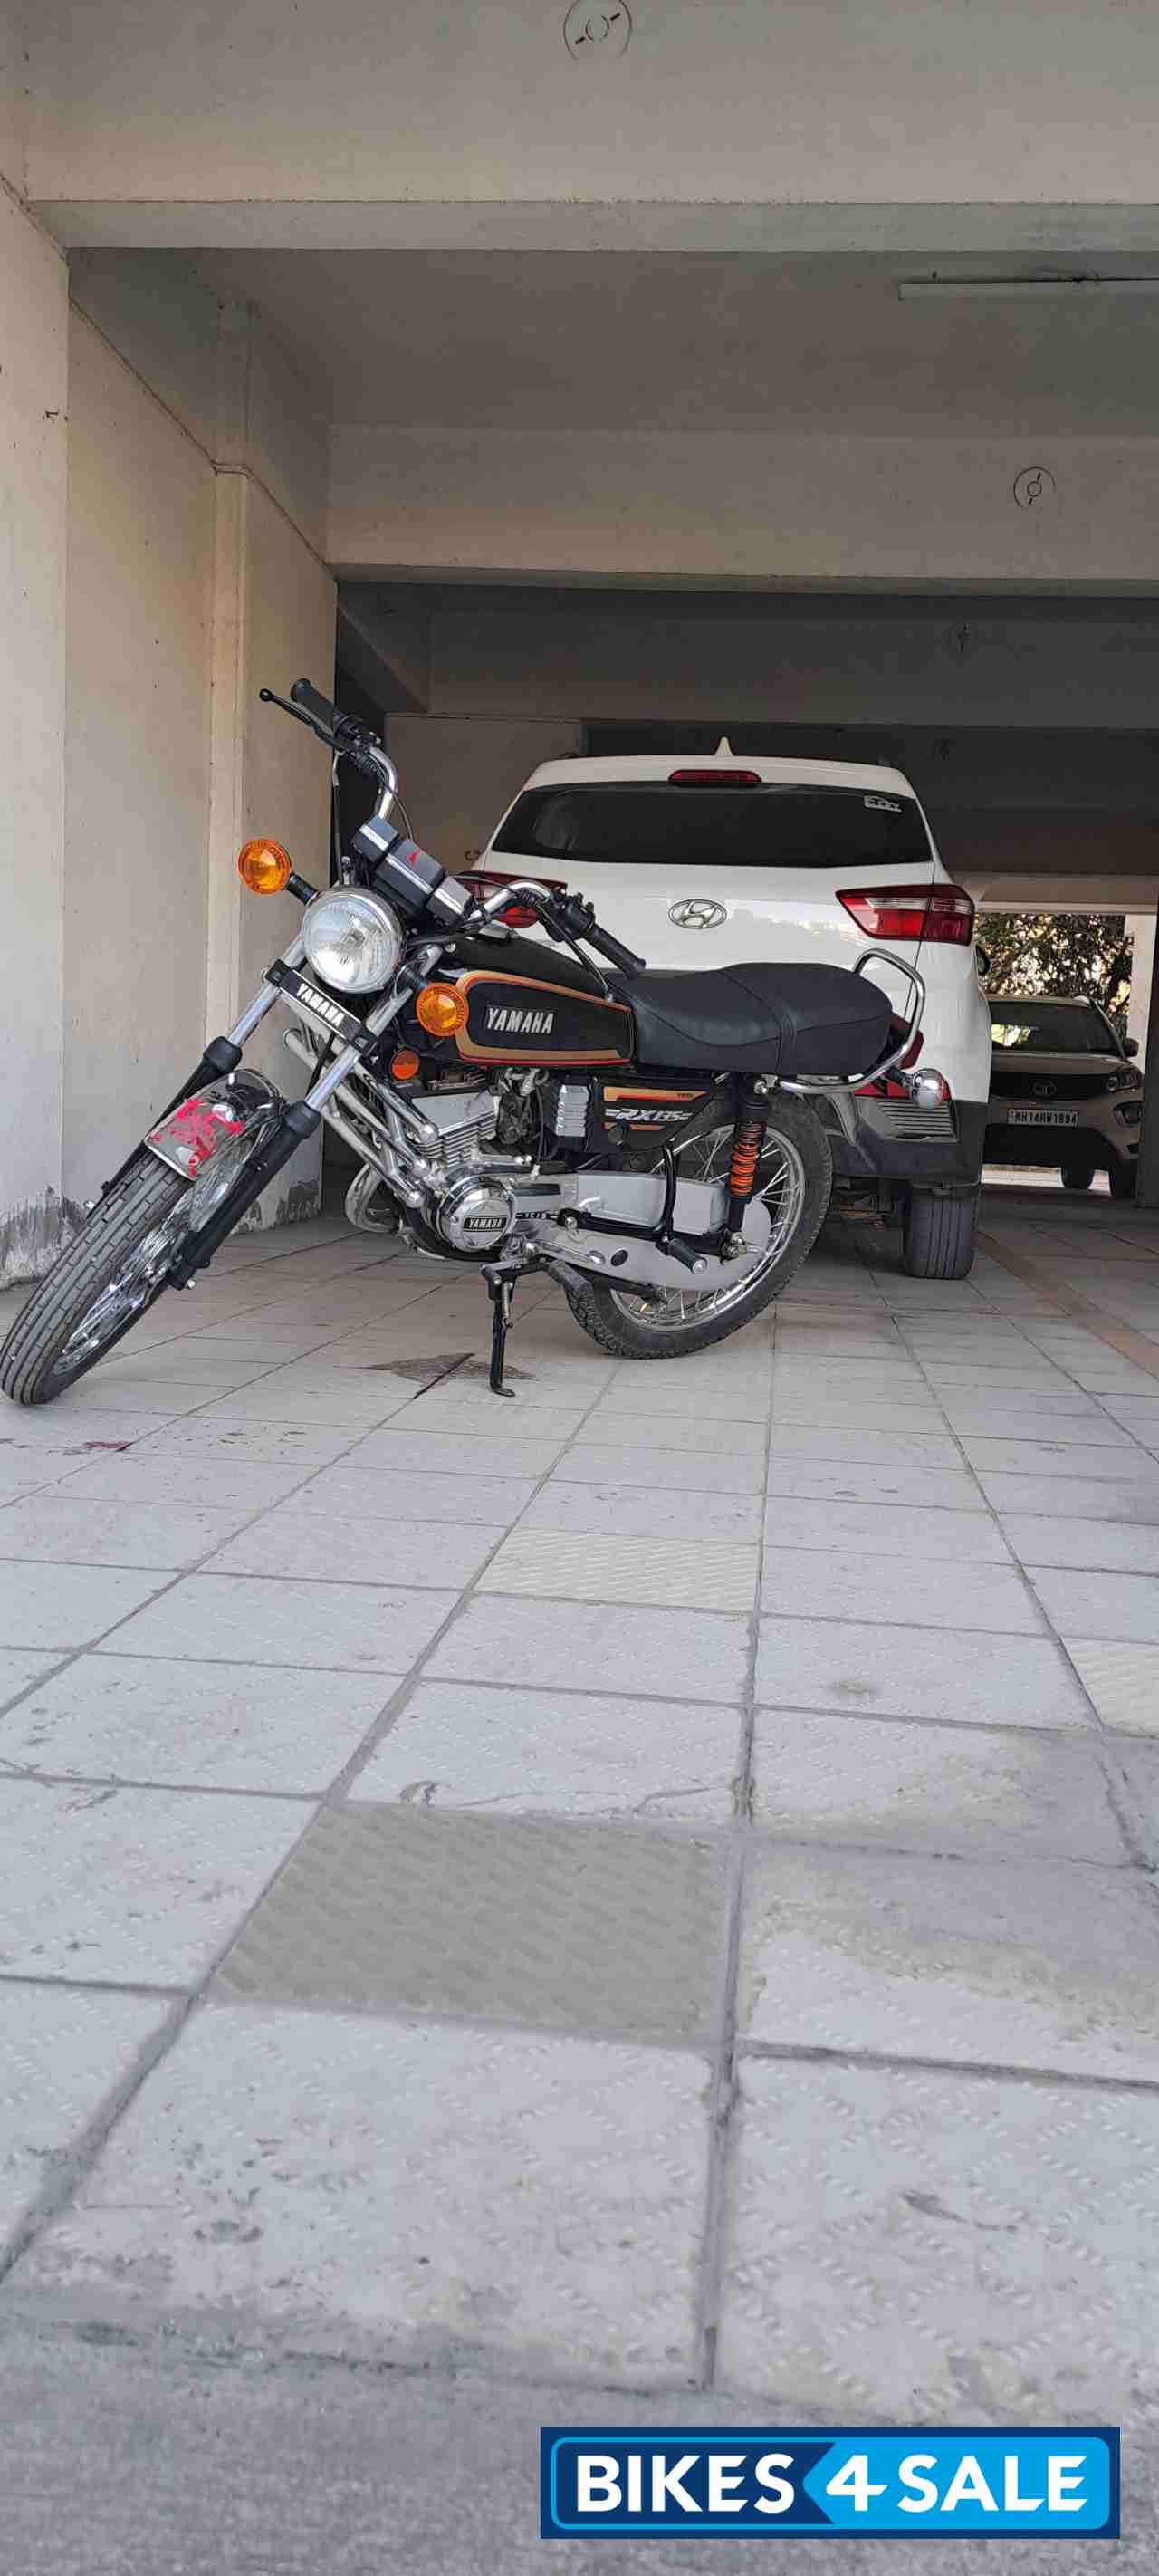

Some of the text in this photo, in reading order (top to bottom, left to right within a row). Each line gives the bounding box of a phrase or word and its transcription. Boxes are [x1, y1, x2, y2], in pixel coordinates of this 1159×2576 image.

[296, 983, 345, 1027] YAMAHA
[487, 1007, 554, 1034] YAMAHA
[468, 1217, 503, 1229] YAMAHA
